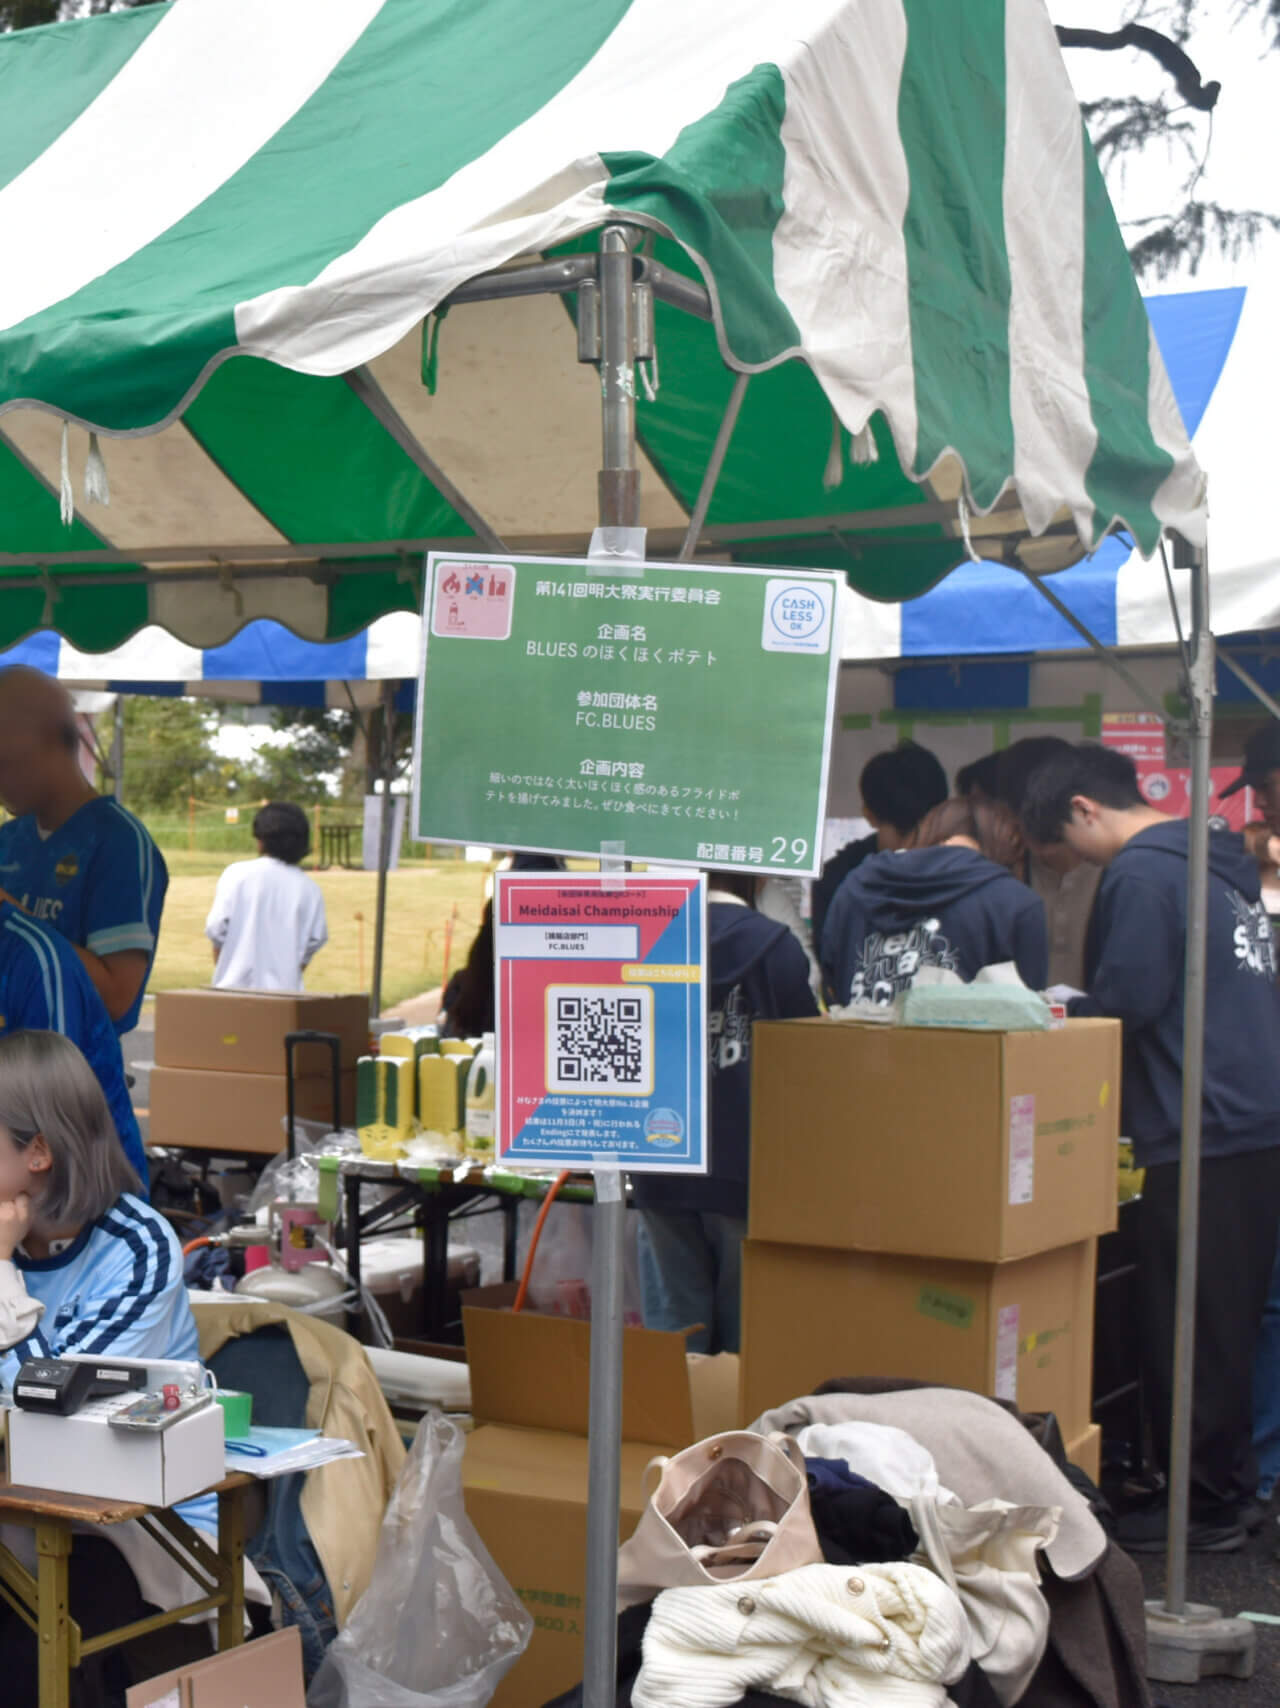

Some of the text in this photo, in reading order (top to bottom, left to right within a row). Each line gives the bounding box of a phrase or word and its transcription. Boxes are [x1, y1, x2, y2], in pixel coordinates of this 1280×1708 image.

[782, 598, 815, 610] CASH
[783, 611, 812, 621] LESS
[597, 623, 647, 642] 企画名
[526, 640, 717, 666] BLUES のほくほくポテト
[577, 690, 658, 711] 参加団体名
[575, 711, 656, 731] FC.BLUES
[579, 758, 645, 778] 企画内容
[696, 836, 809, 864] 配置番号 29
[518, 904, 680, 919] Meidaisai Championship
[549, 943, 585, 951] FC.BLUES
